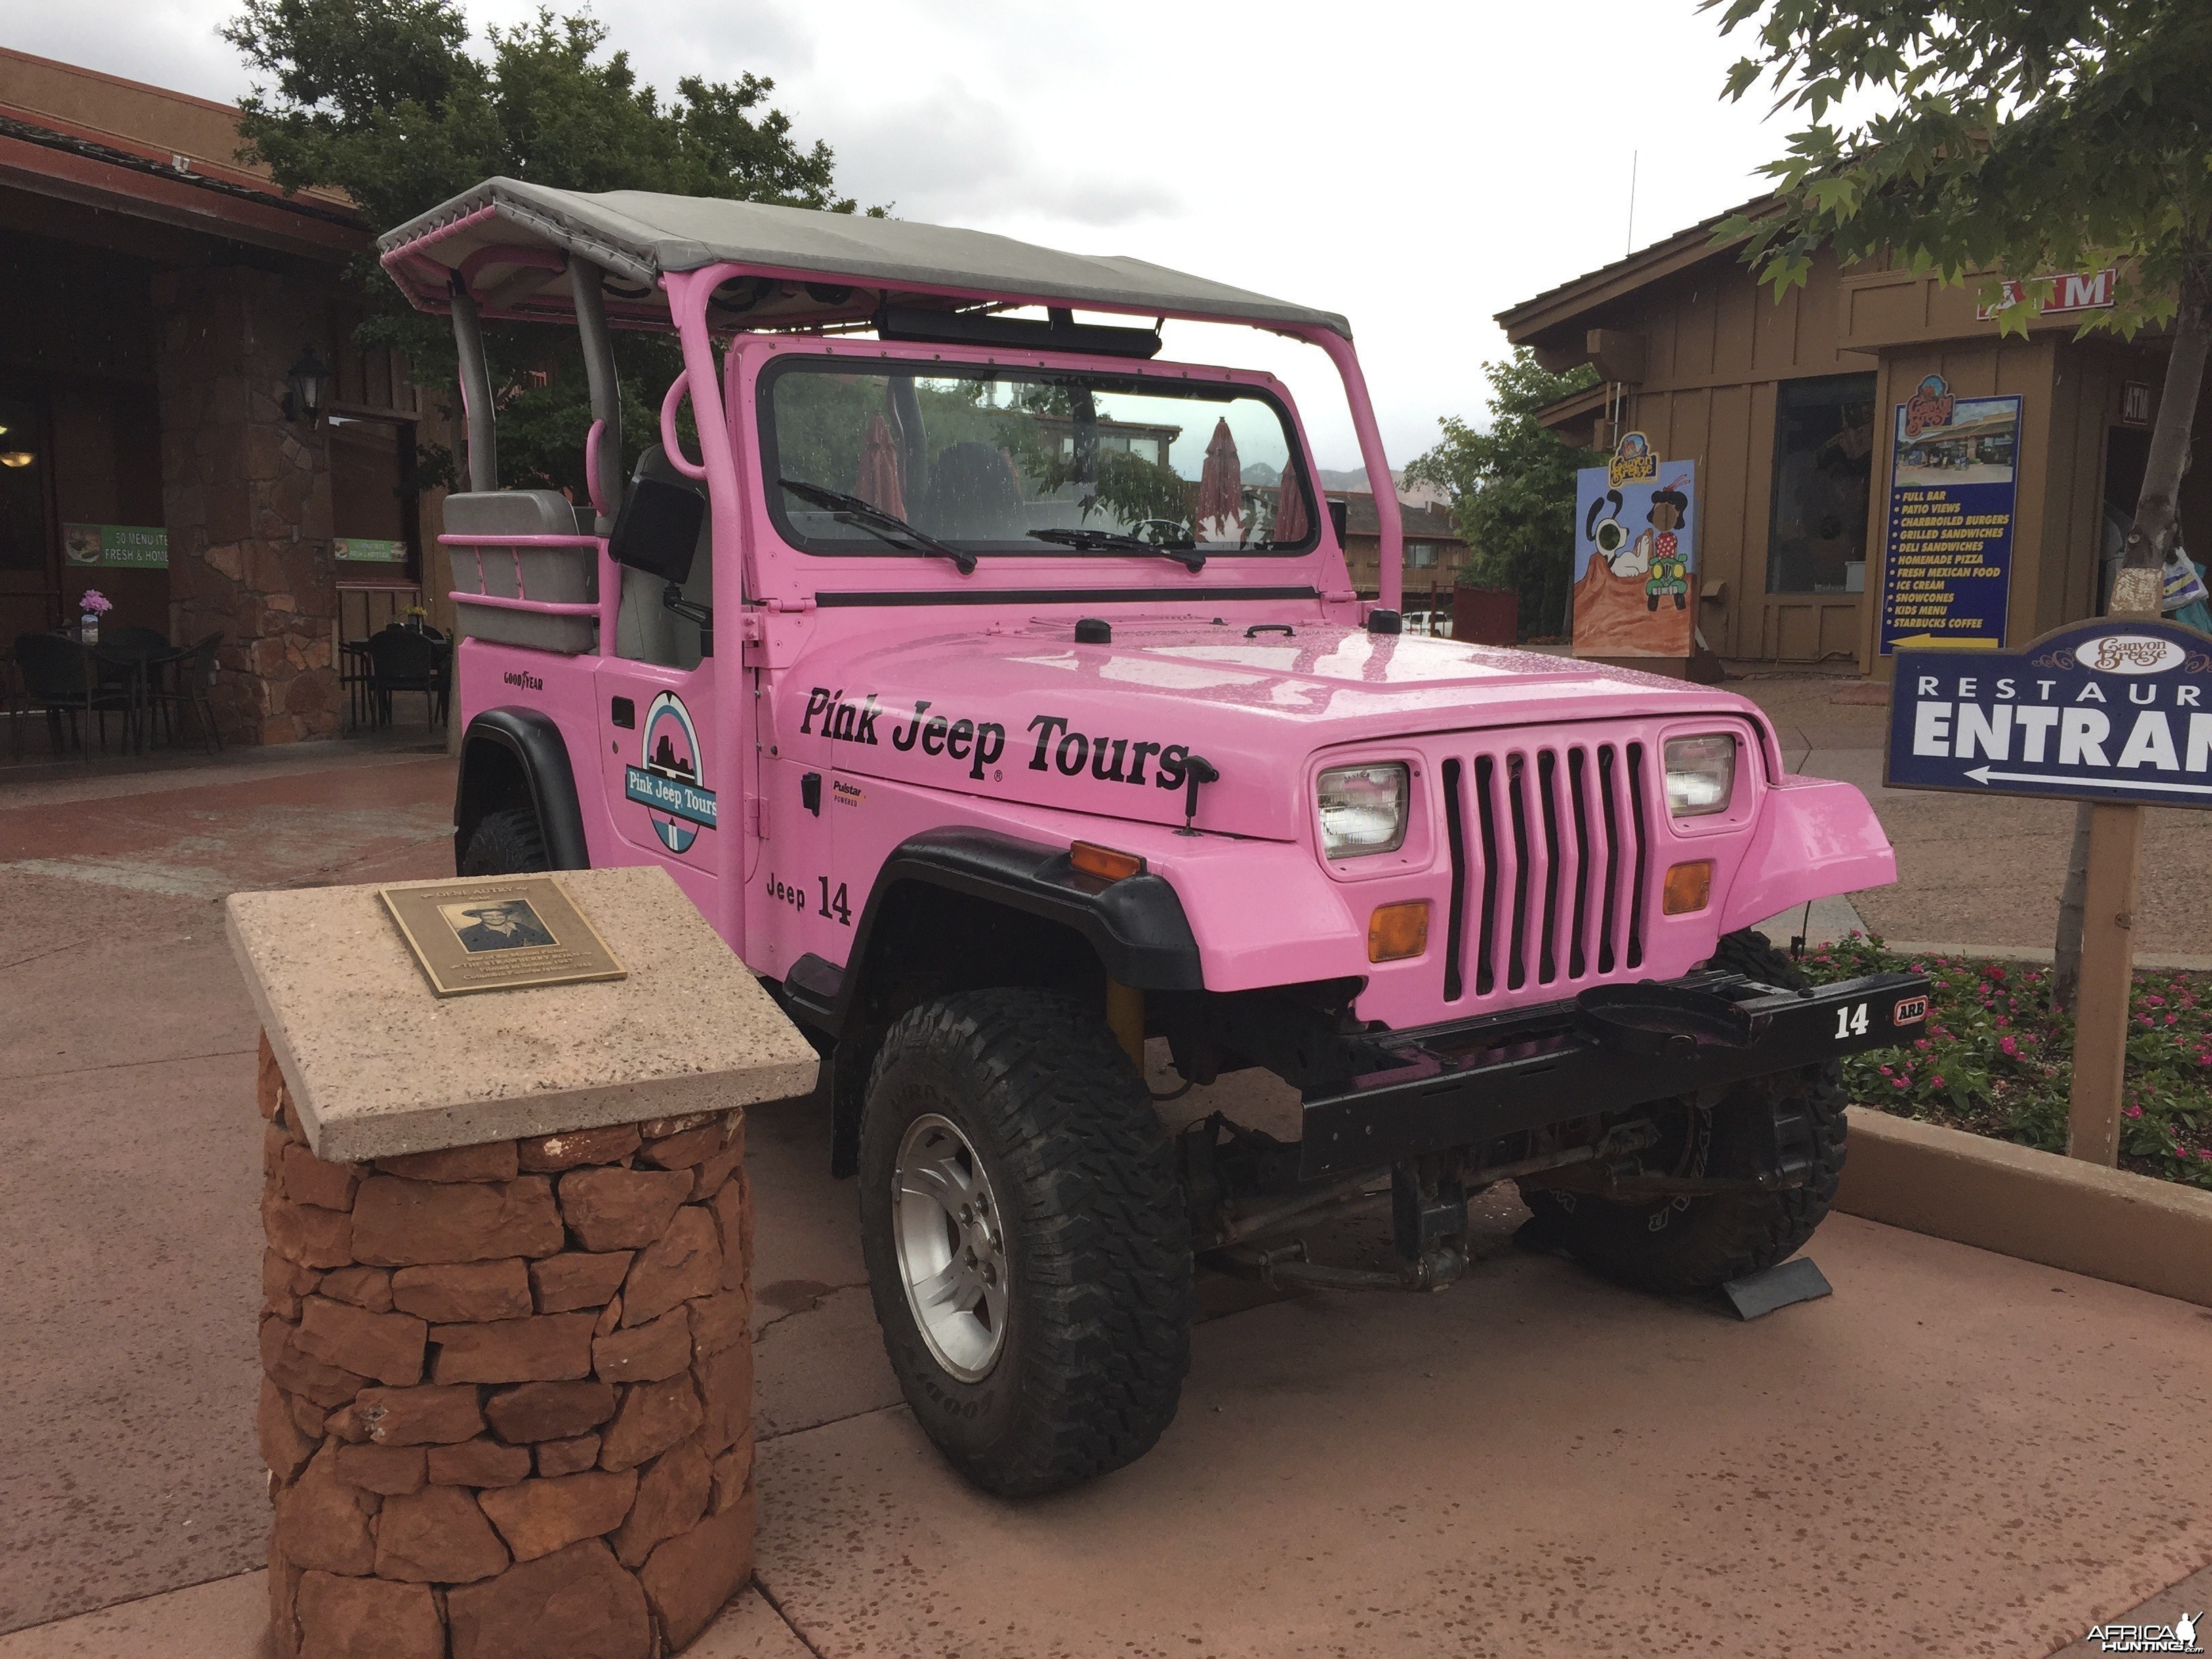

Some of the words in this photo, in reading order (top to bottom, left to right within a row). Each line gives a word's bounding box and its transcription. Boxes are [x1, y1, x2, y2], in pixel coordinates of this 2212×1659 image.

[1985, 273, 2106, 316] AM
[2125, 386, 2149, 419] ATM
[1902, 491, 1924, 501] FULL
[1927, 491, 1946, 501] BAR
[1902, 504, 1929, 514] PATIO
[1931, 503, 1961, 513] VIEWS
[1901, 516, 1963, 527] CHARBROILED
[1965, 514, 2009, 525] BURGERS
[128, 533, 153, 546] MENU
[1900, 529, 1938, 539] GRILLED
[1940, 528, 2004, 539] SANDWICHES
[1899, 542, 1920, 552] DELI
[1921, 541, 1984, 552] SANDWICHES
[105, 549, 134, 560] FRESH
[136, 550, 143, 561] &
[1898, 555, 1952, 565] HOMEMADE
[1954, 555, 1984, 565] PIZZA
[1898, 568, 1926, 577] FRESH
[1927, 568, 1970, 577] MEXICAN
[1973, 568, 2001, 577] FOOD
[1896, 581, 1911, 590] ICE
[1912, 581, 1945, 590] CREAM
[1895, 593, 1954, 602] SNOWCONES
[1895, 606, 1917, 615] KIDS
[1919, 606, 1947, 615] MENU
[1893, 619, 1946, 628] STARBUCKS
[1948, 619, 1983, 628] COFFEE
[2098, 638, 2167, 653] Canyon
[2095, 649, 2167, 670] Breeze
[1917, 676, 2201, 707] RESTAUR
[800, 687, 883, 746] Pink
[892, 700, 1006, 781] Jeep
[1027, 714, 1191, 791] Tours
[629, 771, 653, 796] Pink
[655, 780, 682, 810] Jeep
[684, 788, 717, 817] Tours
[833, 780, 862, 797] Pulstar
[834, 795, 857, 807] POWERED
[766, 872, 805, 912] Jeep
[818, 876, 852, 927] 14
[1835, 1002, 1870, 1040] 14
[1898, 1001, 1925, 1021] ARB
